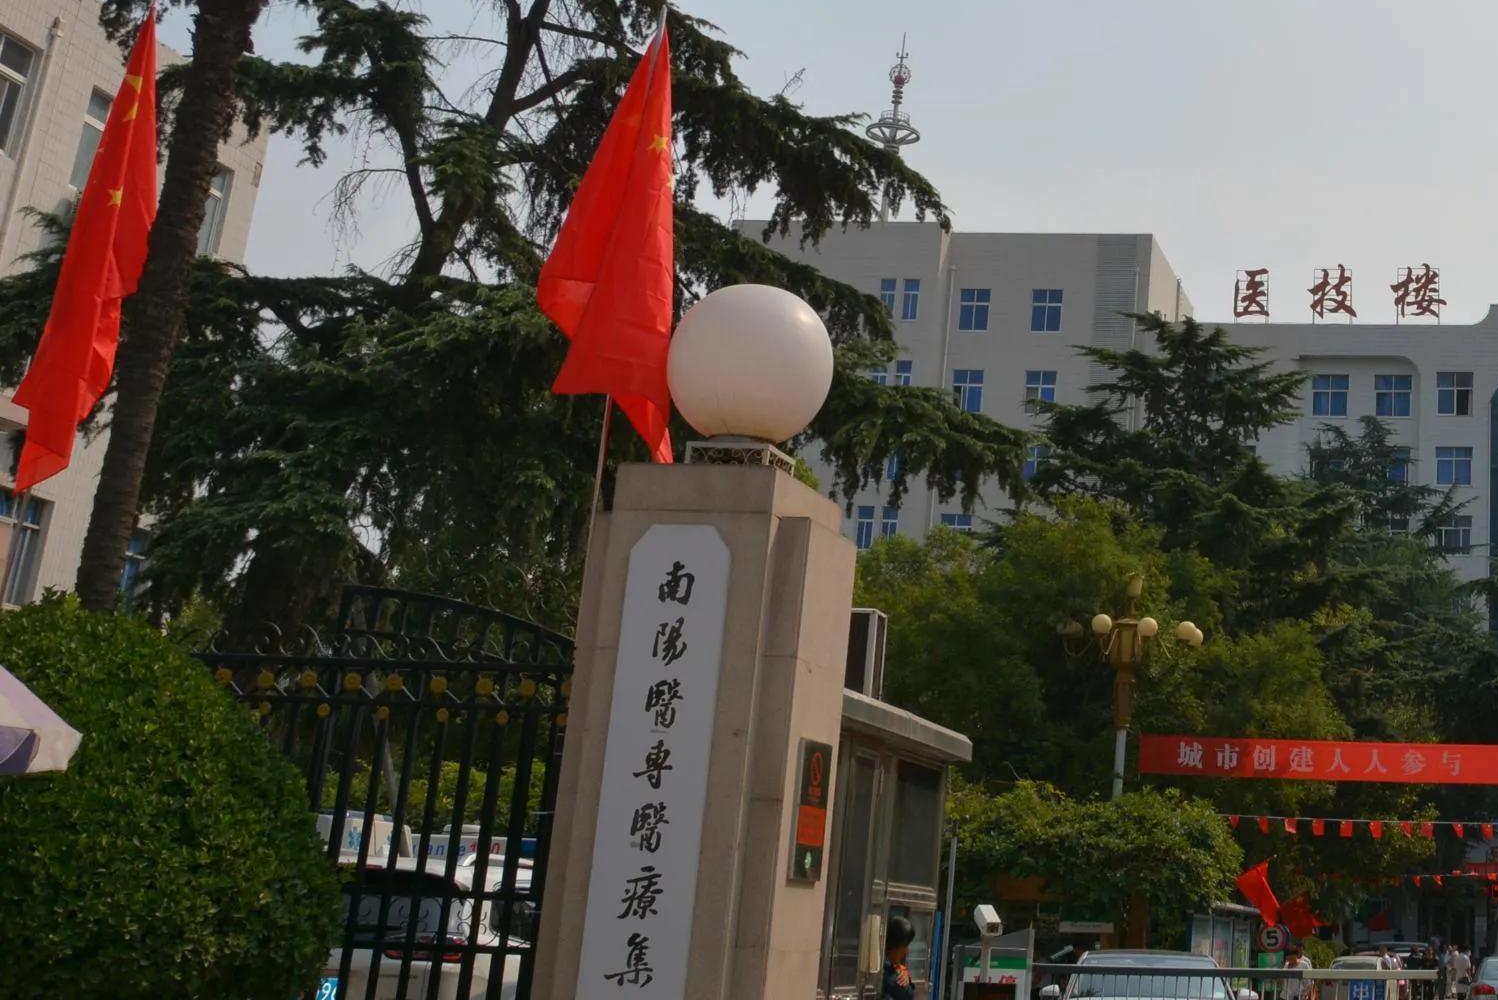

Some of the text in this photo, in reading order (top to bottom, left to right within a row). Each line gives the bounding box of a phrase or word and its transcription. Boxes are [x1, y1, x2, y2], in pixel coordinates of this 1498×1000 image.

[1234, 263, 1447, 318] 医技楼
[1177, 741, 1462, 777] 城市创建人人参与
[1266, 929, 1279, 947] 5
